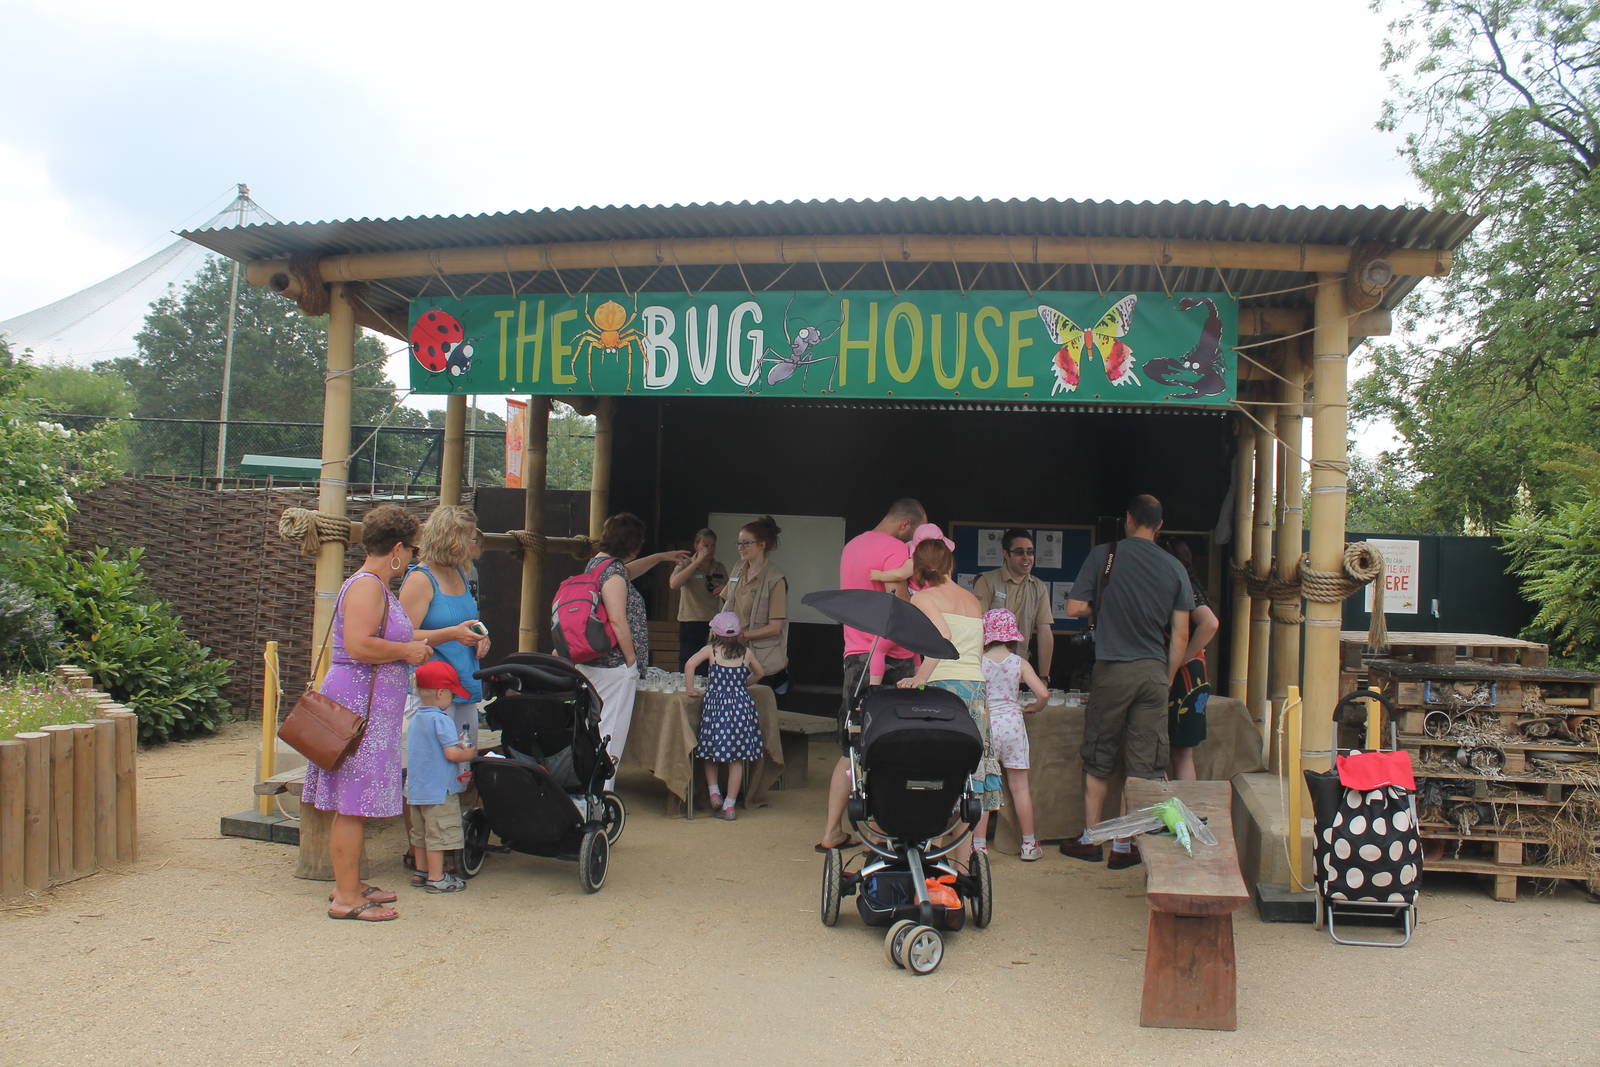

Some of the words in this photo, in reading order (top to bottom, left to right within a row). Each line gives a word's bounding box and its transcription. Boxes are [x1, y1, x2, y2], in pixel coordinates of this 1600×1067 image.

[494, 300, 578, 385] THE
[642, 301, 763, 390] BUG
[839, 298, 1038, 390] HOUSE
[1386, 576, 1409, 591] ERE
